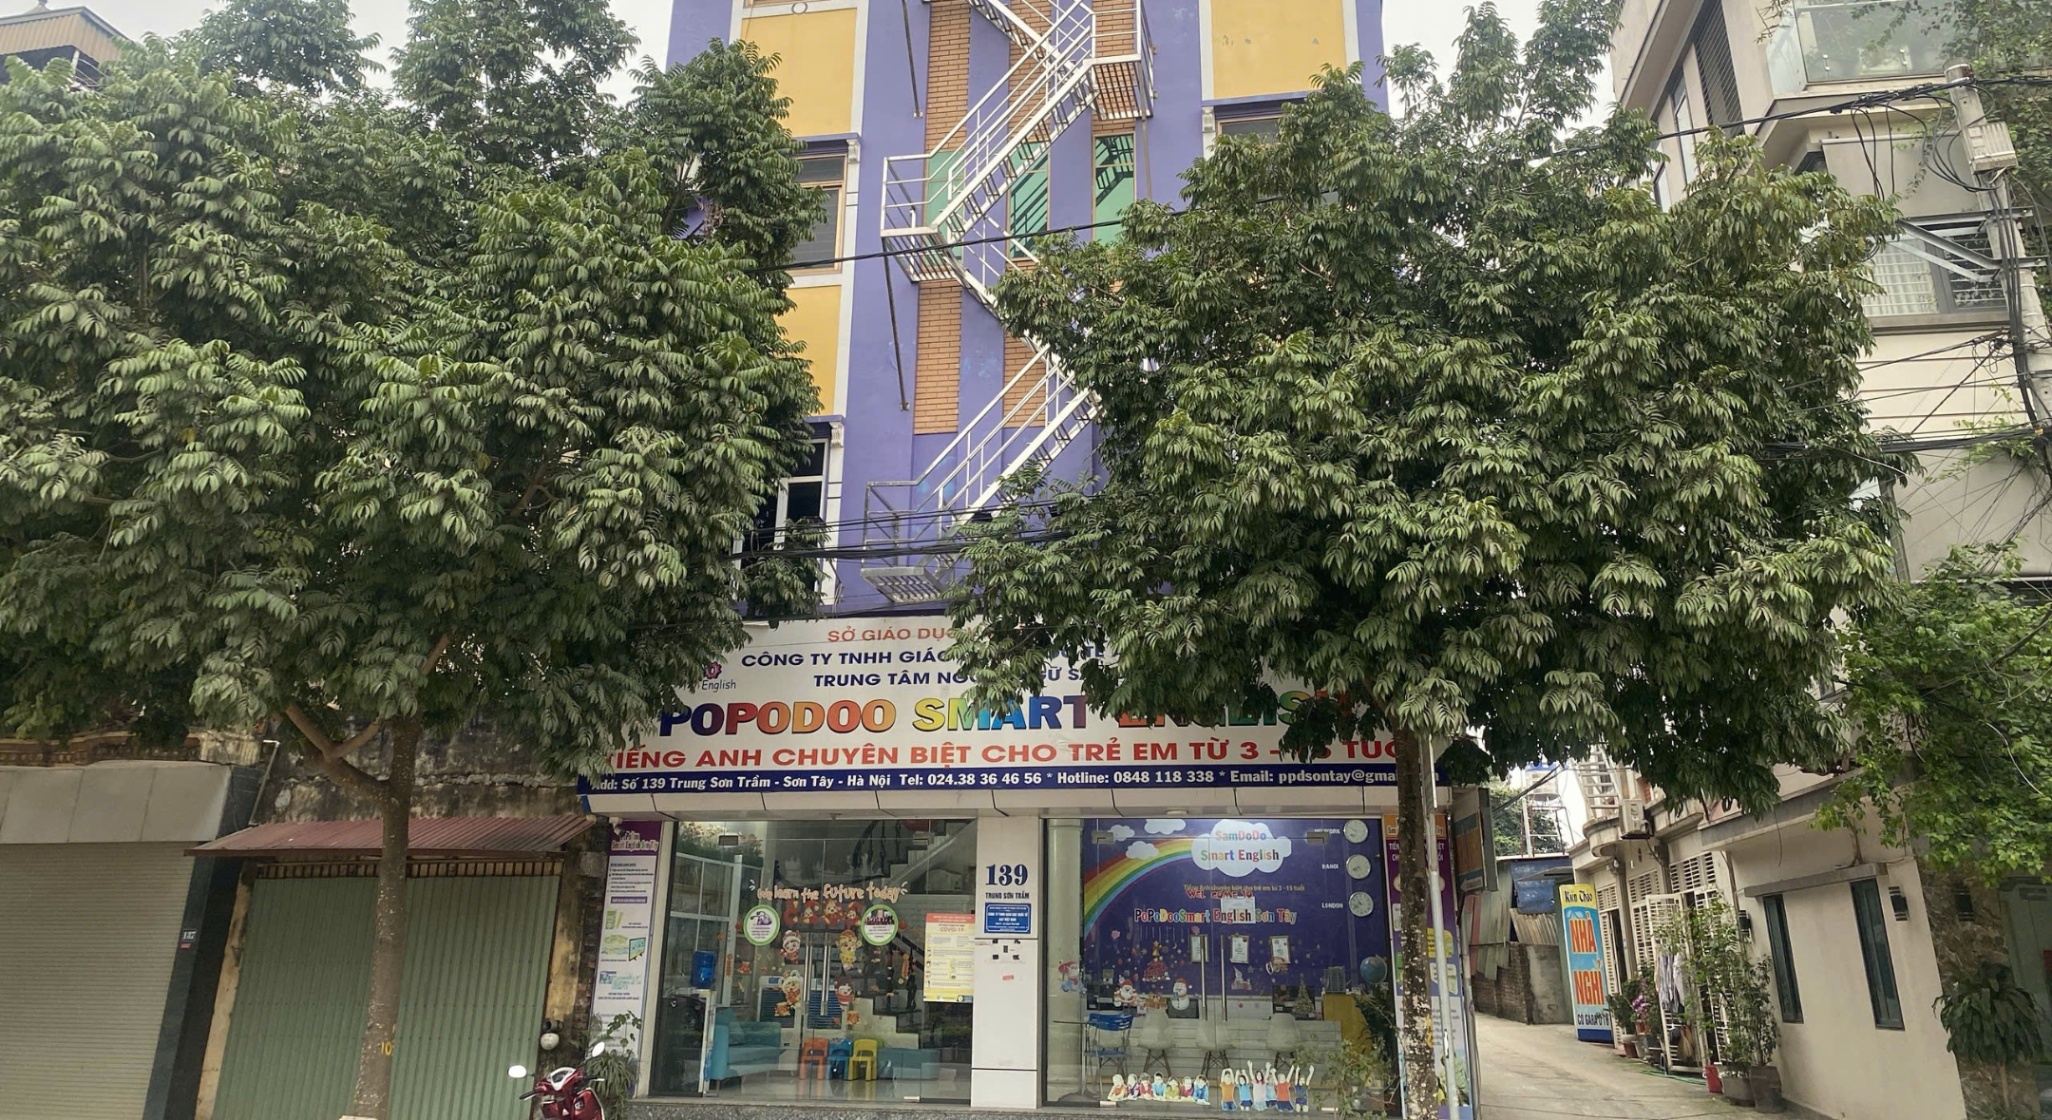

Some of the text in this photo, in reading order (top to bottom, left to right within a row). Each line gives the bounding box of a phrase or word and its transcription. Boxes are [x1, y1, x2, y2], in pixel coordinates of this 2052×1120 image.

[827, 626, 856, 642] SỞ
[862, 626, 912, 641] GIÁO
[741, 651, 804, 667] CÔNG
[810, 653, 832, 665] TY
[839, 651, 892, 665] TNHH
[701, 679, 737, 692] English
[814, 674, 881, 687] TRUNG
[888, 669, 930, 685] TÂM
[659, 698, 897, 737] POPODOO
[912, 695, 1088, 733] SMART
[695, 750, 761, 767] ANH
[772, 743, 898, 766] CHUYÊN
[910, 741, 972, 769] BIỆT
[981, 744, 1057, 763] CHO
[1068, 737, 1121, 761] TRẺ
[1133, 742, 1178, 761] EM
[1189, 737, 1230, 760] TỪ
[1240, 741, 1258, 759] 3
[621, 777, 638, 790] Số
[642, 777, 666, 789] 139
[670, 777, 706, 791] Trung
[710, 776, 733, 788] Sơn
[737, 775, 770, 788] Trầm
[783, 775, 807, 788] Sơn
[811, 775, 834, 789] Tây
[847, 774, 864, 787] Hà
[869, 774, 891, 788] Nội
[899, 773, 924, 786] Tel:
[927, 773, 975, 786] 024.38
[979, 773, 998, 785] 36
[1002, 773, 1020, 785] 46
[1024, 772, 1042, 784] 56
[1057, 771, 1109, 784] Hotline:
[1113, 771, 1150, 784] 0848
[1155, 771, 1183, 783] 118
[1187, 770, 1214, 783] 338
[1230, 770, 1274, 783] Email:
[1200, 849, 1280, 863] Smart English
[985, 863, 1029, 887] 139
[774, 885, 799, 899] learn
[801, 887, 819, 903] the
[866, 881, 900, 903] today
[1213, 908, 1253, 924] English
[1277, 907, 1298, 925] Tây
